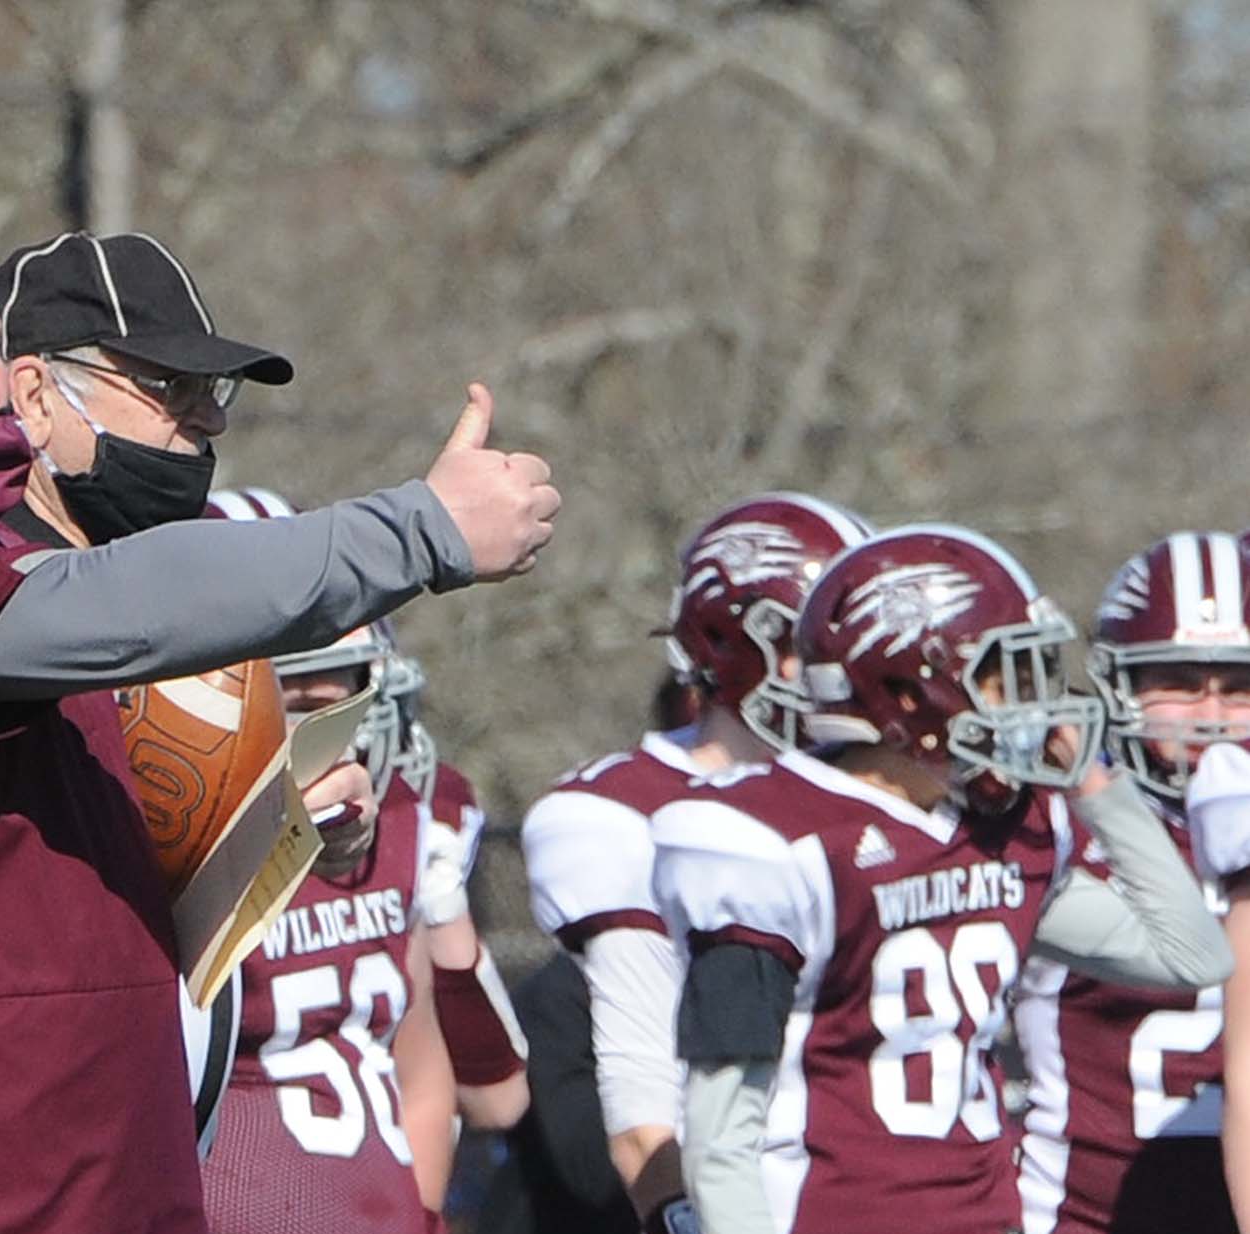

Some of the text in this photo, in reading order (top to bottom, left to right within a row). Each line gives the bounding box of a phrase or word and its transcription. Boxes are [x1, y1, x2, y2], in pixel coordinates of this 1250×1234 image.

[261, 888, 407, 961] WILDCATS
[872, 861, 1025, 930] WILDCATS
[259, 951, 415, 1167] 58
[869, 920, 1019, 1142] 88
